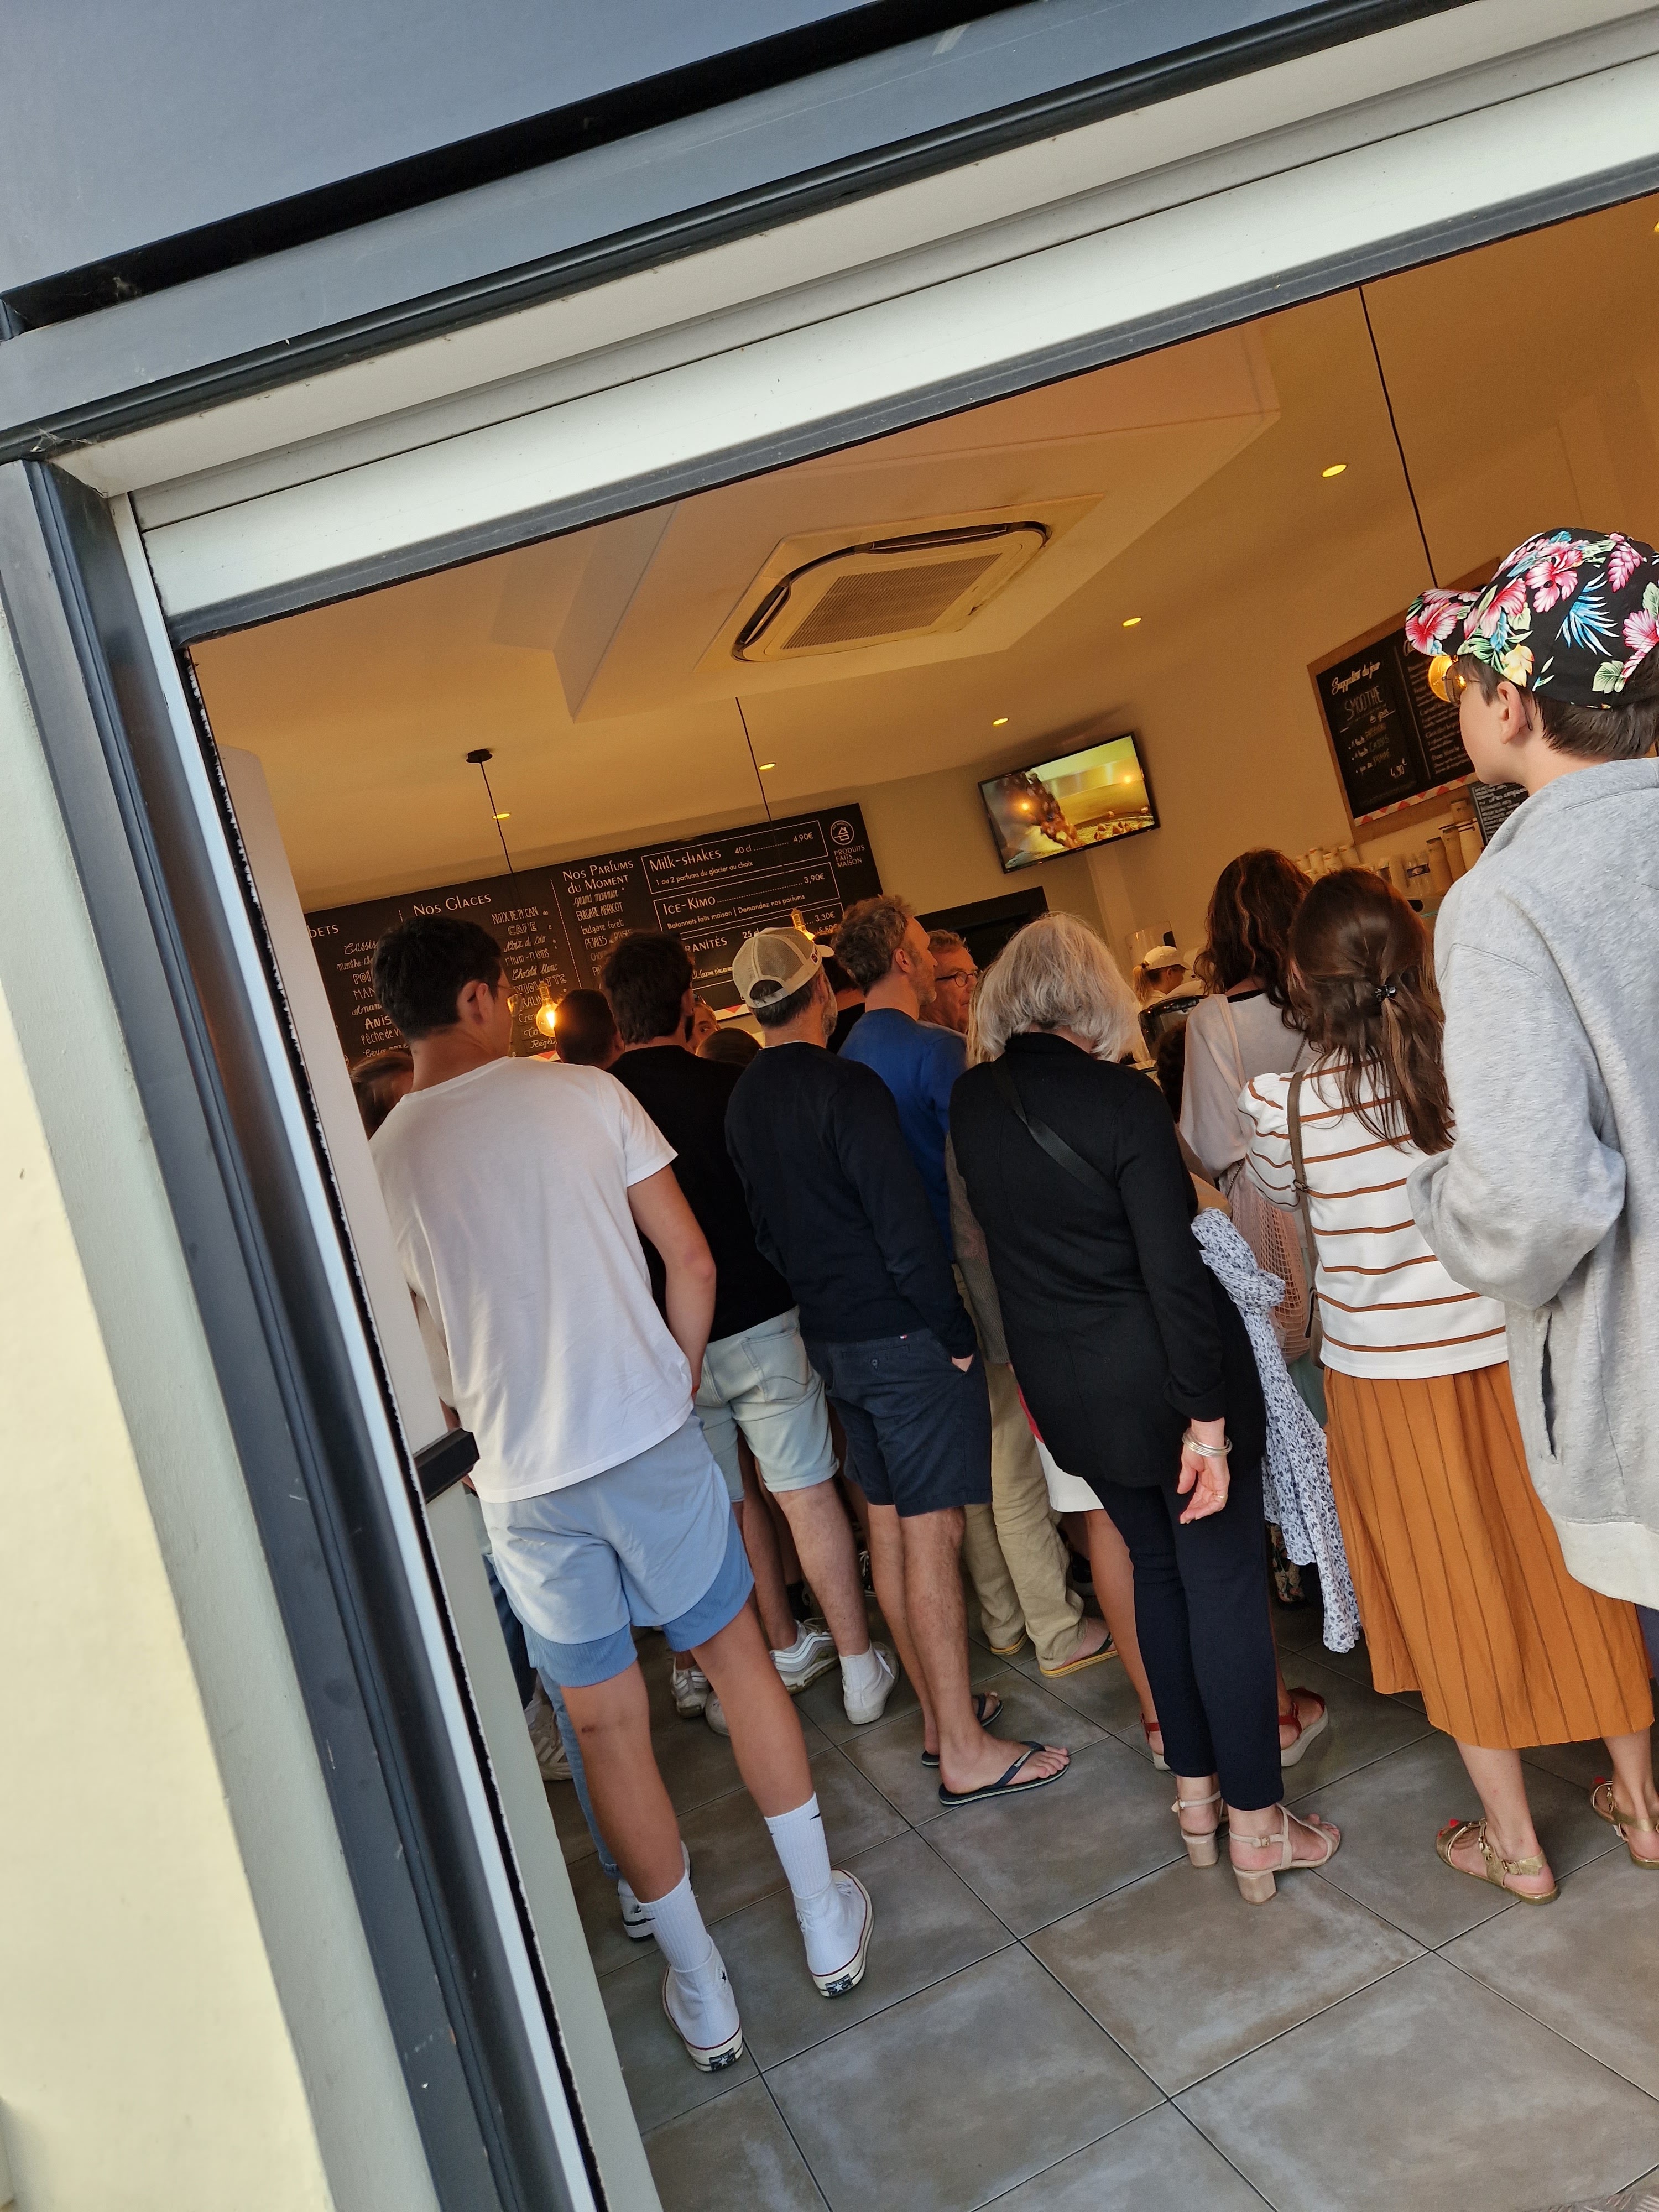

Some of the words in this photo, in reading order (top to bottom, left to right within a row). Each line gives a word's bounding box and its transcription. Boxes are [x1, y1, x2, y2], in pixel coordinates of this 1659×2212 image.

[793, 832, 814, 843] 4,90€
[833, 844, 865, 856] PRODUITS
[836, 854, 853, 862] FAITS
[837, 858, 862, 868] MAISON
[676, 873, 700, 883] parfums
[709, 866, 728, 876] glacier
[737, 860, 753, 869] choix
[804, 873, 825, 884] 3,90€
[568, 881, 581, 894] du
[601, 901, 623, 916] ABRICOT
[711, 911, 732, 919] maison
[738, 902, 770, 914] Demandez
[782, 894, 805, 905] parfums
[491, 910, 510, 925] NOIX
[815, 911, 835, 922] 3,30€
[742, 930, 752, 939] 25
